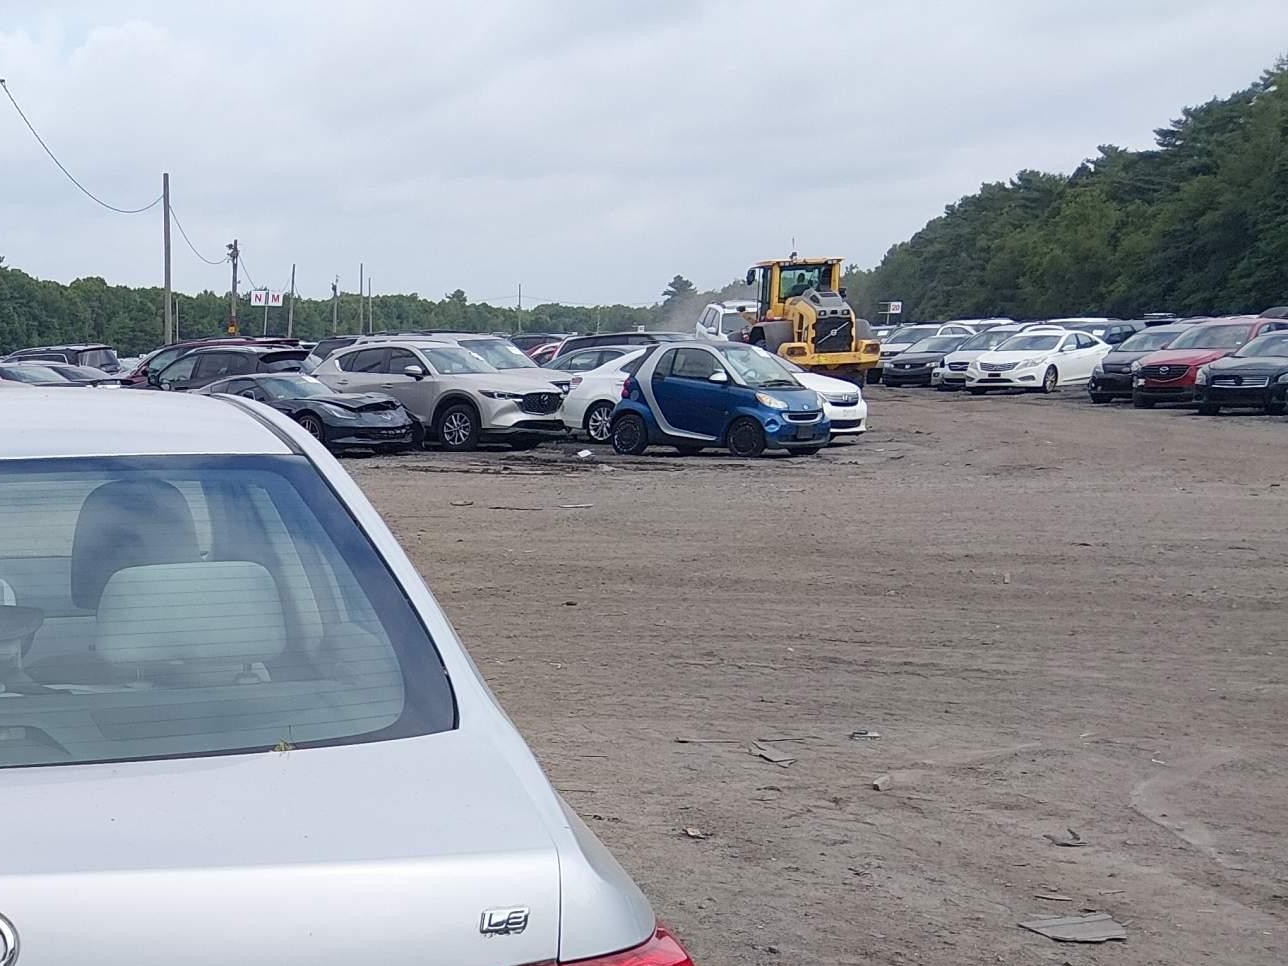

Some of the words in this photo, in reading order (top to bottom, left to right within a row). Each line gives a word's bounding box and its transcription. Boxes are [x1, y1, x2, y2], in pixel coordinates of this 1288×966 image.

[254, 293, 262, 303] N
[271, 294, 280, 303] M
[479, 907, 530, 935] LE
